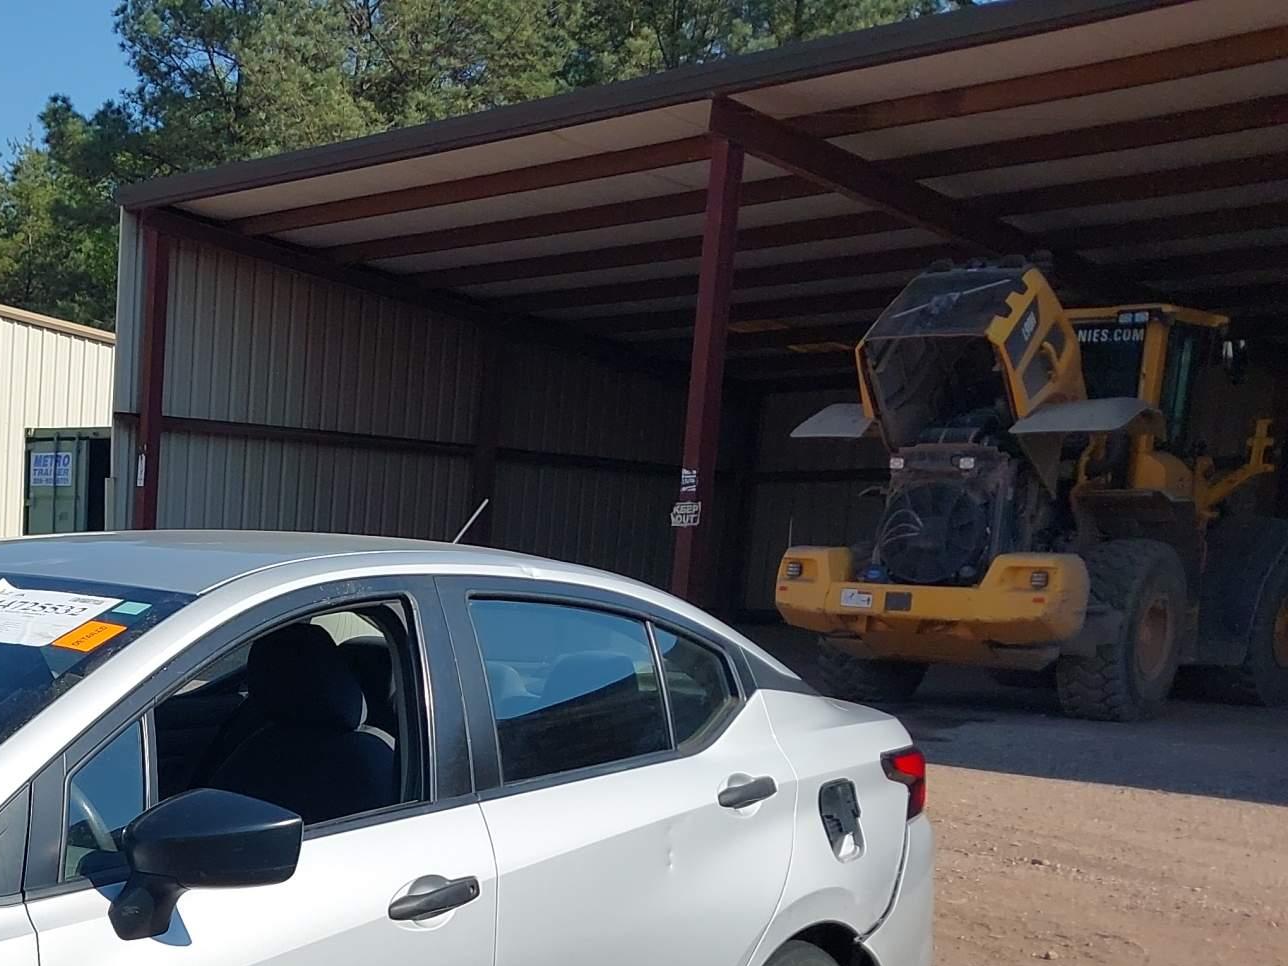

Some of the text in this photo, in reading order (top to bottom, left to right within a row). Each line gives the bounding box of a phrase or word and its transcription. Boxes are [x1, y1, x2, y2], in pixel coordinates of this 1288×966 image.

[34, 454, 70, 468] METRO
[33, 468, 70, 477] TRAIER
[673, 505, 699, 514] KEEP
[675, 514, 698, 524] OUT
